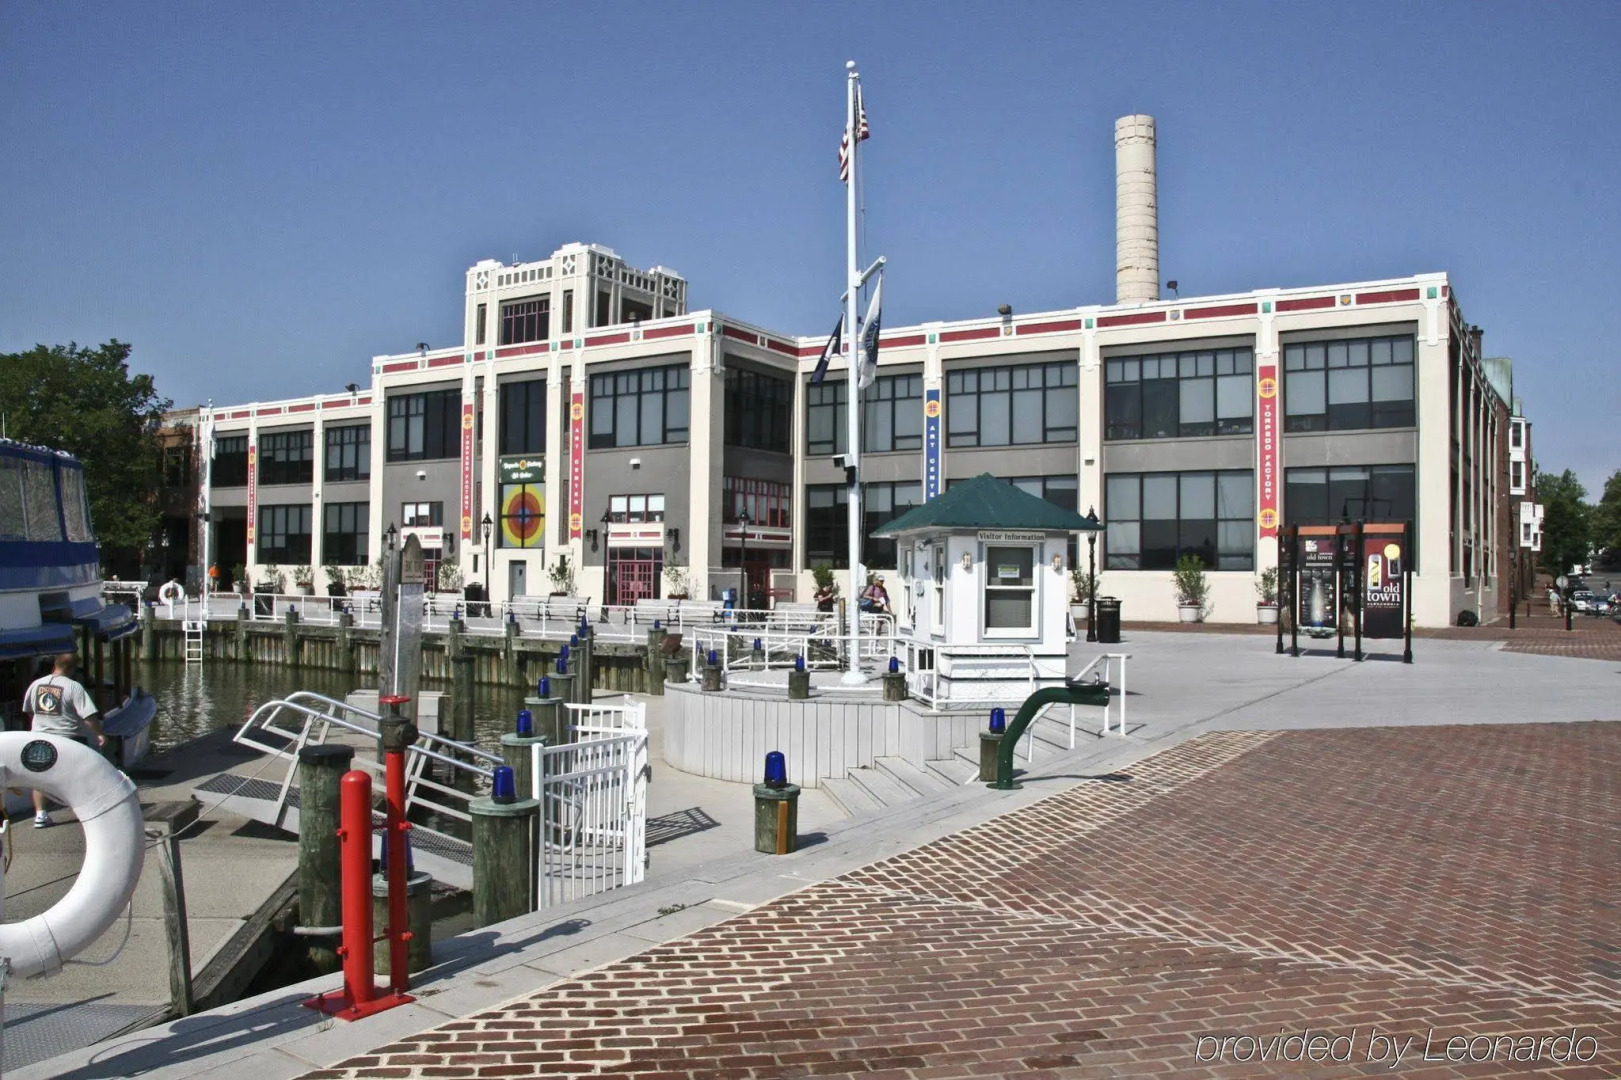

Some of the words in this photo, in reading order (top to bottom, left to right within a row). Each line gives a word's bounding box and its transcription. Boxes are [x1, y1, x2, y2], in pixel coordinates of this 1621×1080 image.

[1264, 455, 1272, 500] FACTORY
[979, 532, 1002, 540] Visitor
[1005, 533, 1045, 541] Information
[1383, 582, 1400, 593] old
[1366, 590, 1401, 602] town
